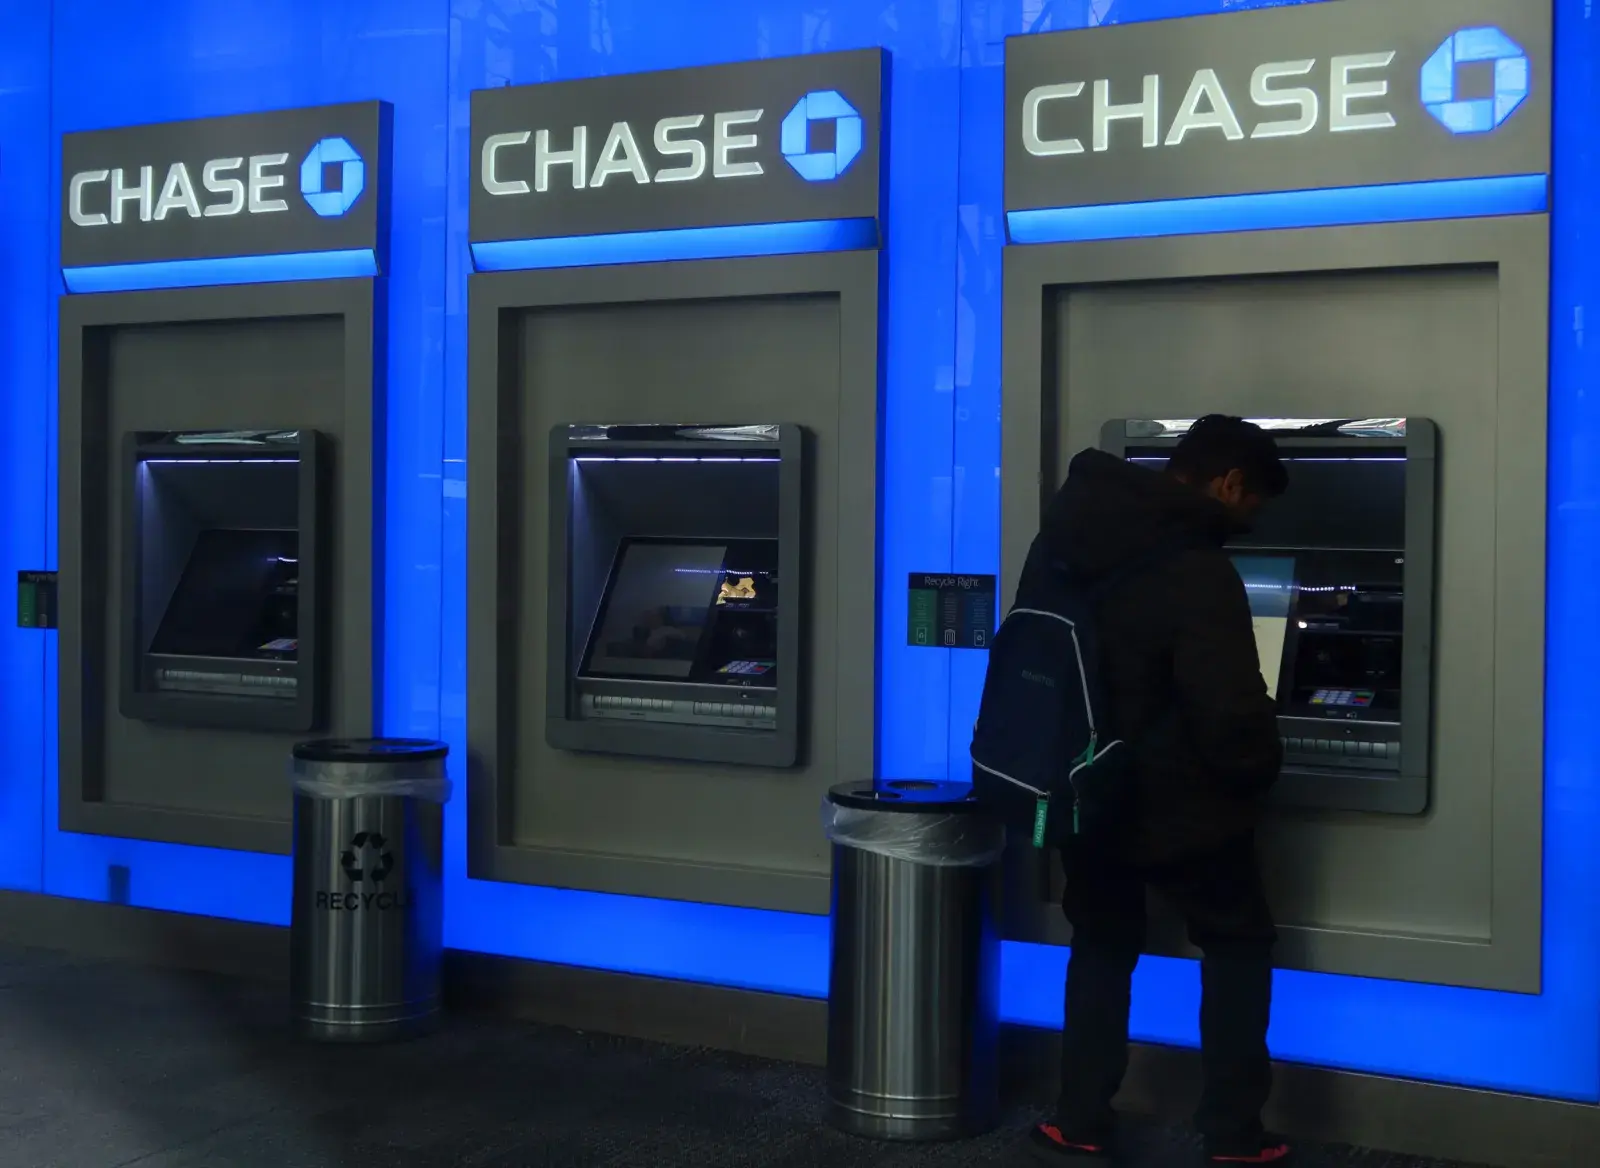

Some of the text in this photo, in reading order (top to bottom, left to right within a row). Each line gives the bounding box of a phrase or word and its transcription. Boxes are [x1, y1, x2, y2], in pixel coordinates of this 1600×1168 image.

[1022, 51, 1396, 156] CHASE
[69, 153, 289, 226] CHASE
[482, 109, 764, 195] CHASE
[924, 575, 955, 589] Recycle
